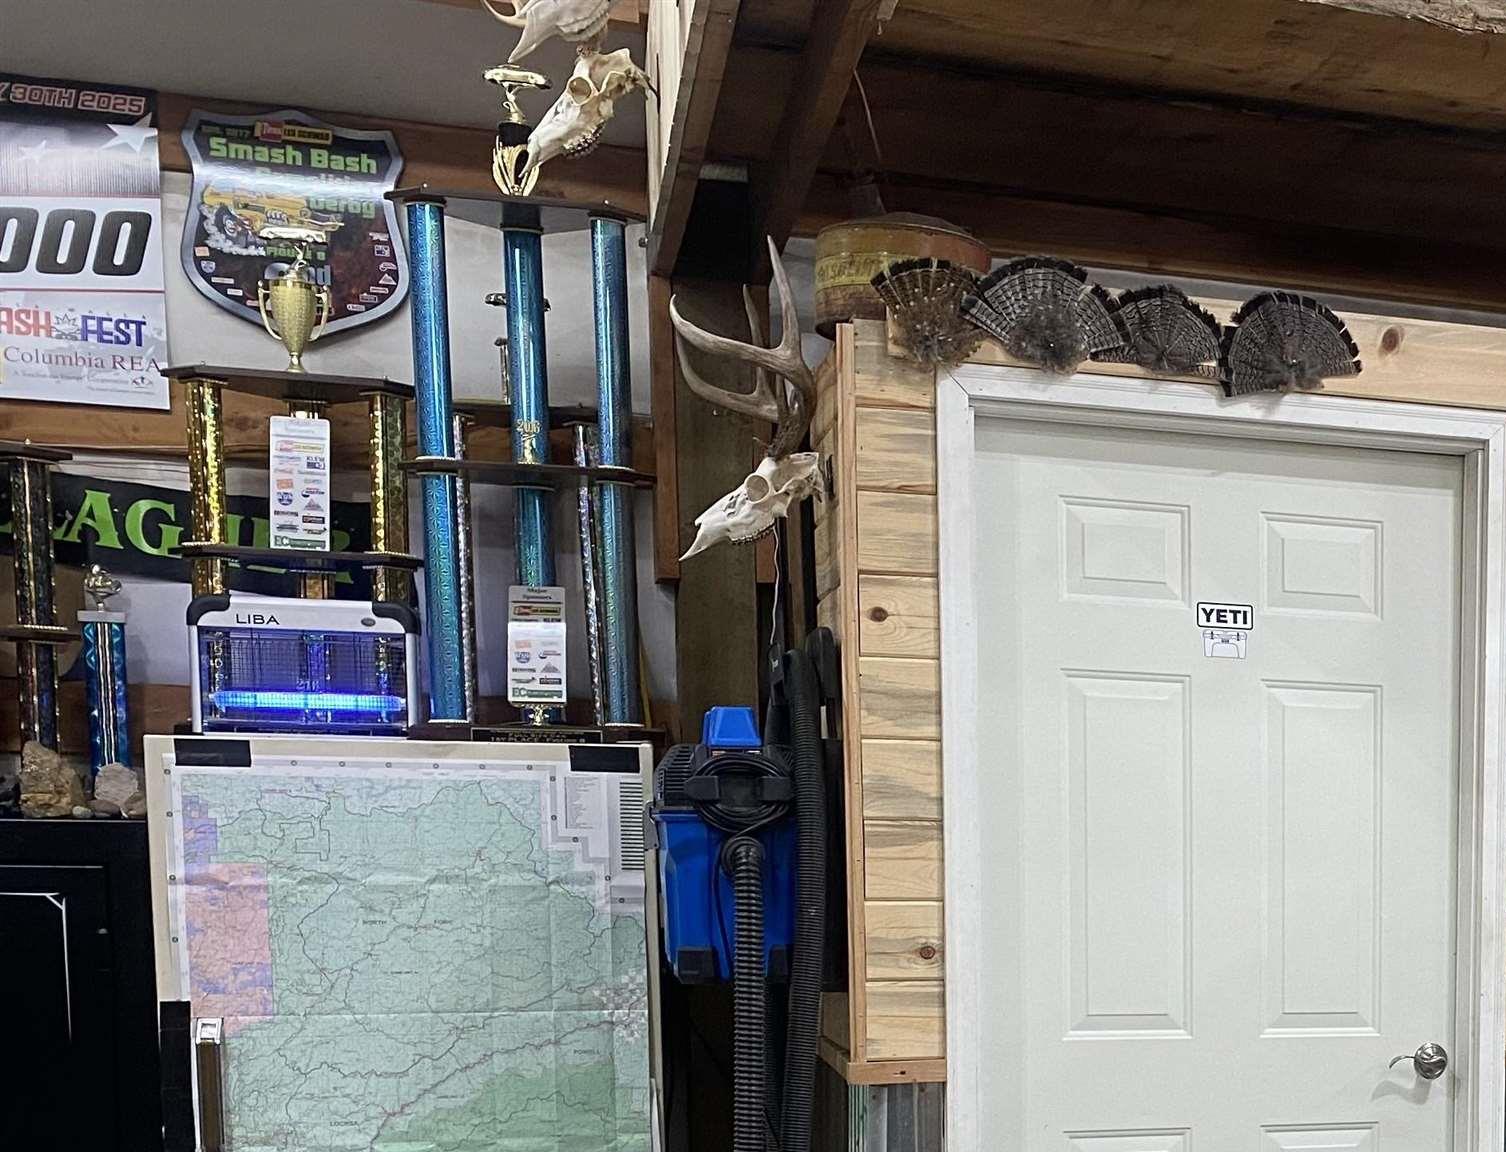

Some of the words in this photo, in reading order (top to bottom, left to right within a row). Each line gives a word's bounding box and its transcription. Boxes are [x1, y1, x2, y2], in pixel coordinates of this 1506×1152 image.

[10, 83, 76, 108] 30TH
[78, 91, 146, 116] 2025
[209, 136, 303, 166] Smash
[309, 148, 378, 175] Bash
[81, 314, 147, 348] FEST
[4, 345, 105, 369] Columbia
[236, 613, 280, 626] LIBA
[1201, 607, 1249, 625] YETI
